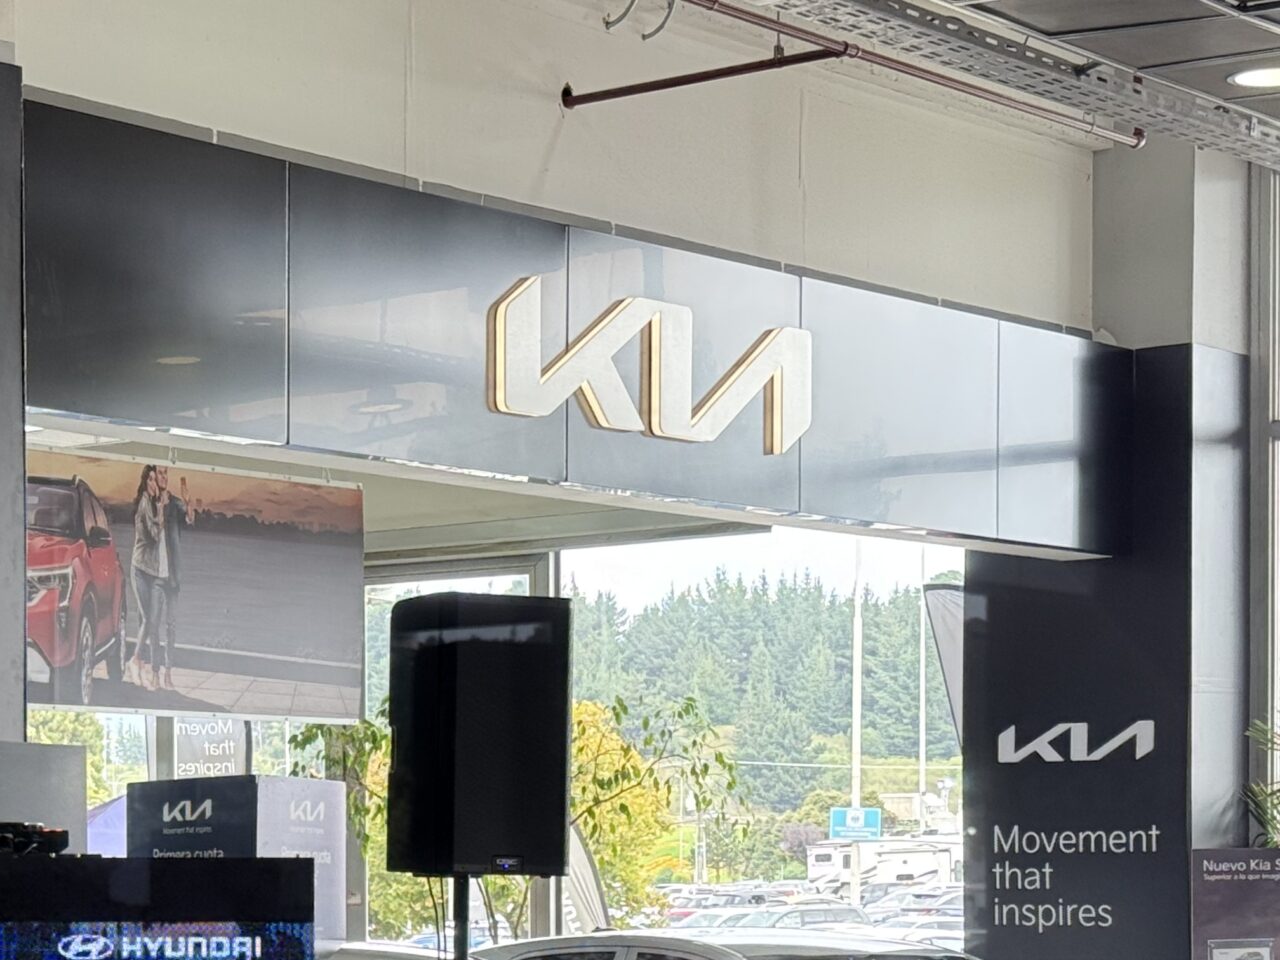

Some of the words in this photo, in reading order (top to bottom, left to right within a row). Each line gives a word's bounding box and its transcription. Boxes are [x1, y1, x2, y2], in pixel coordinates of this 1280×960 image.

[486, 275, 813, 456] KIA
[998, 720, 1155, 763] KIA
[162, 798, 213, 823] KIA
[290, 800, 325, 821] KIA
[993, 824, 1161, 854] Movement
[992, 861, 1054, 890] that
[1203, 859, 1247, 872] Nuevo
[1250, 858, 1271, 871] Kia
[993, 897, 1113, 933] inspires
[122, 936, 262, 958] HYUNDAI
